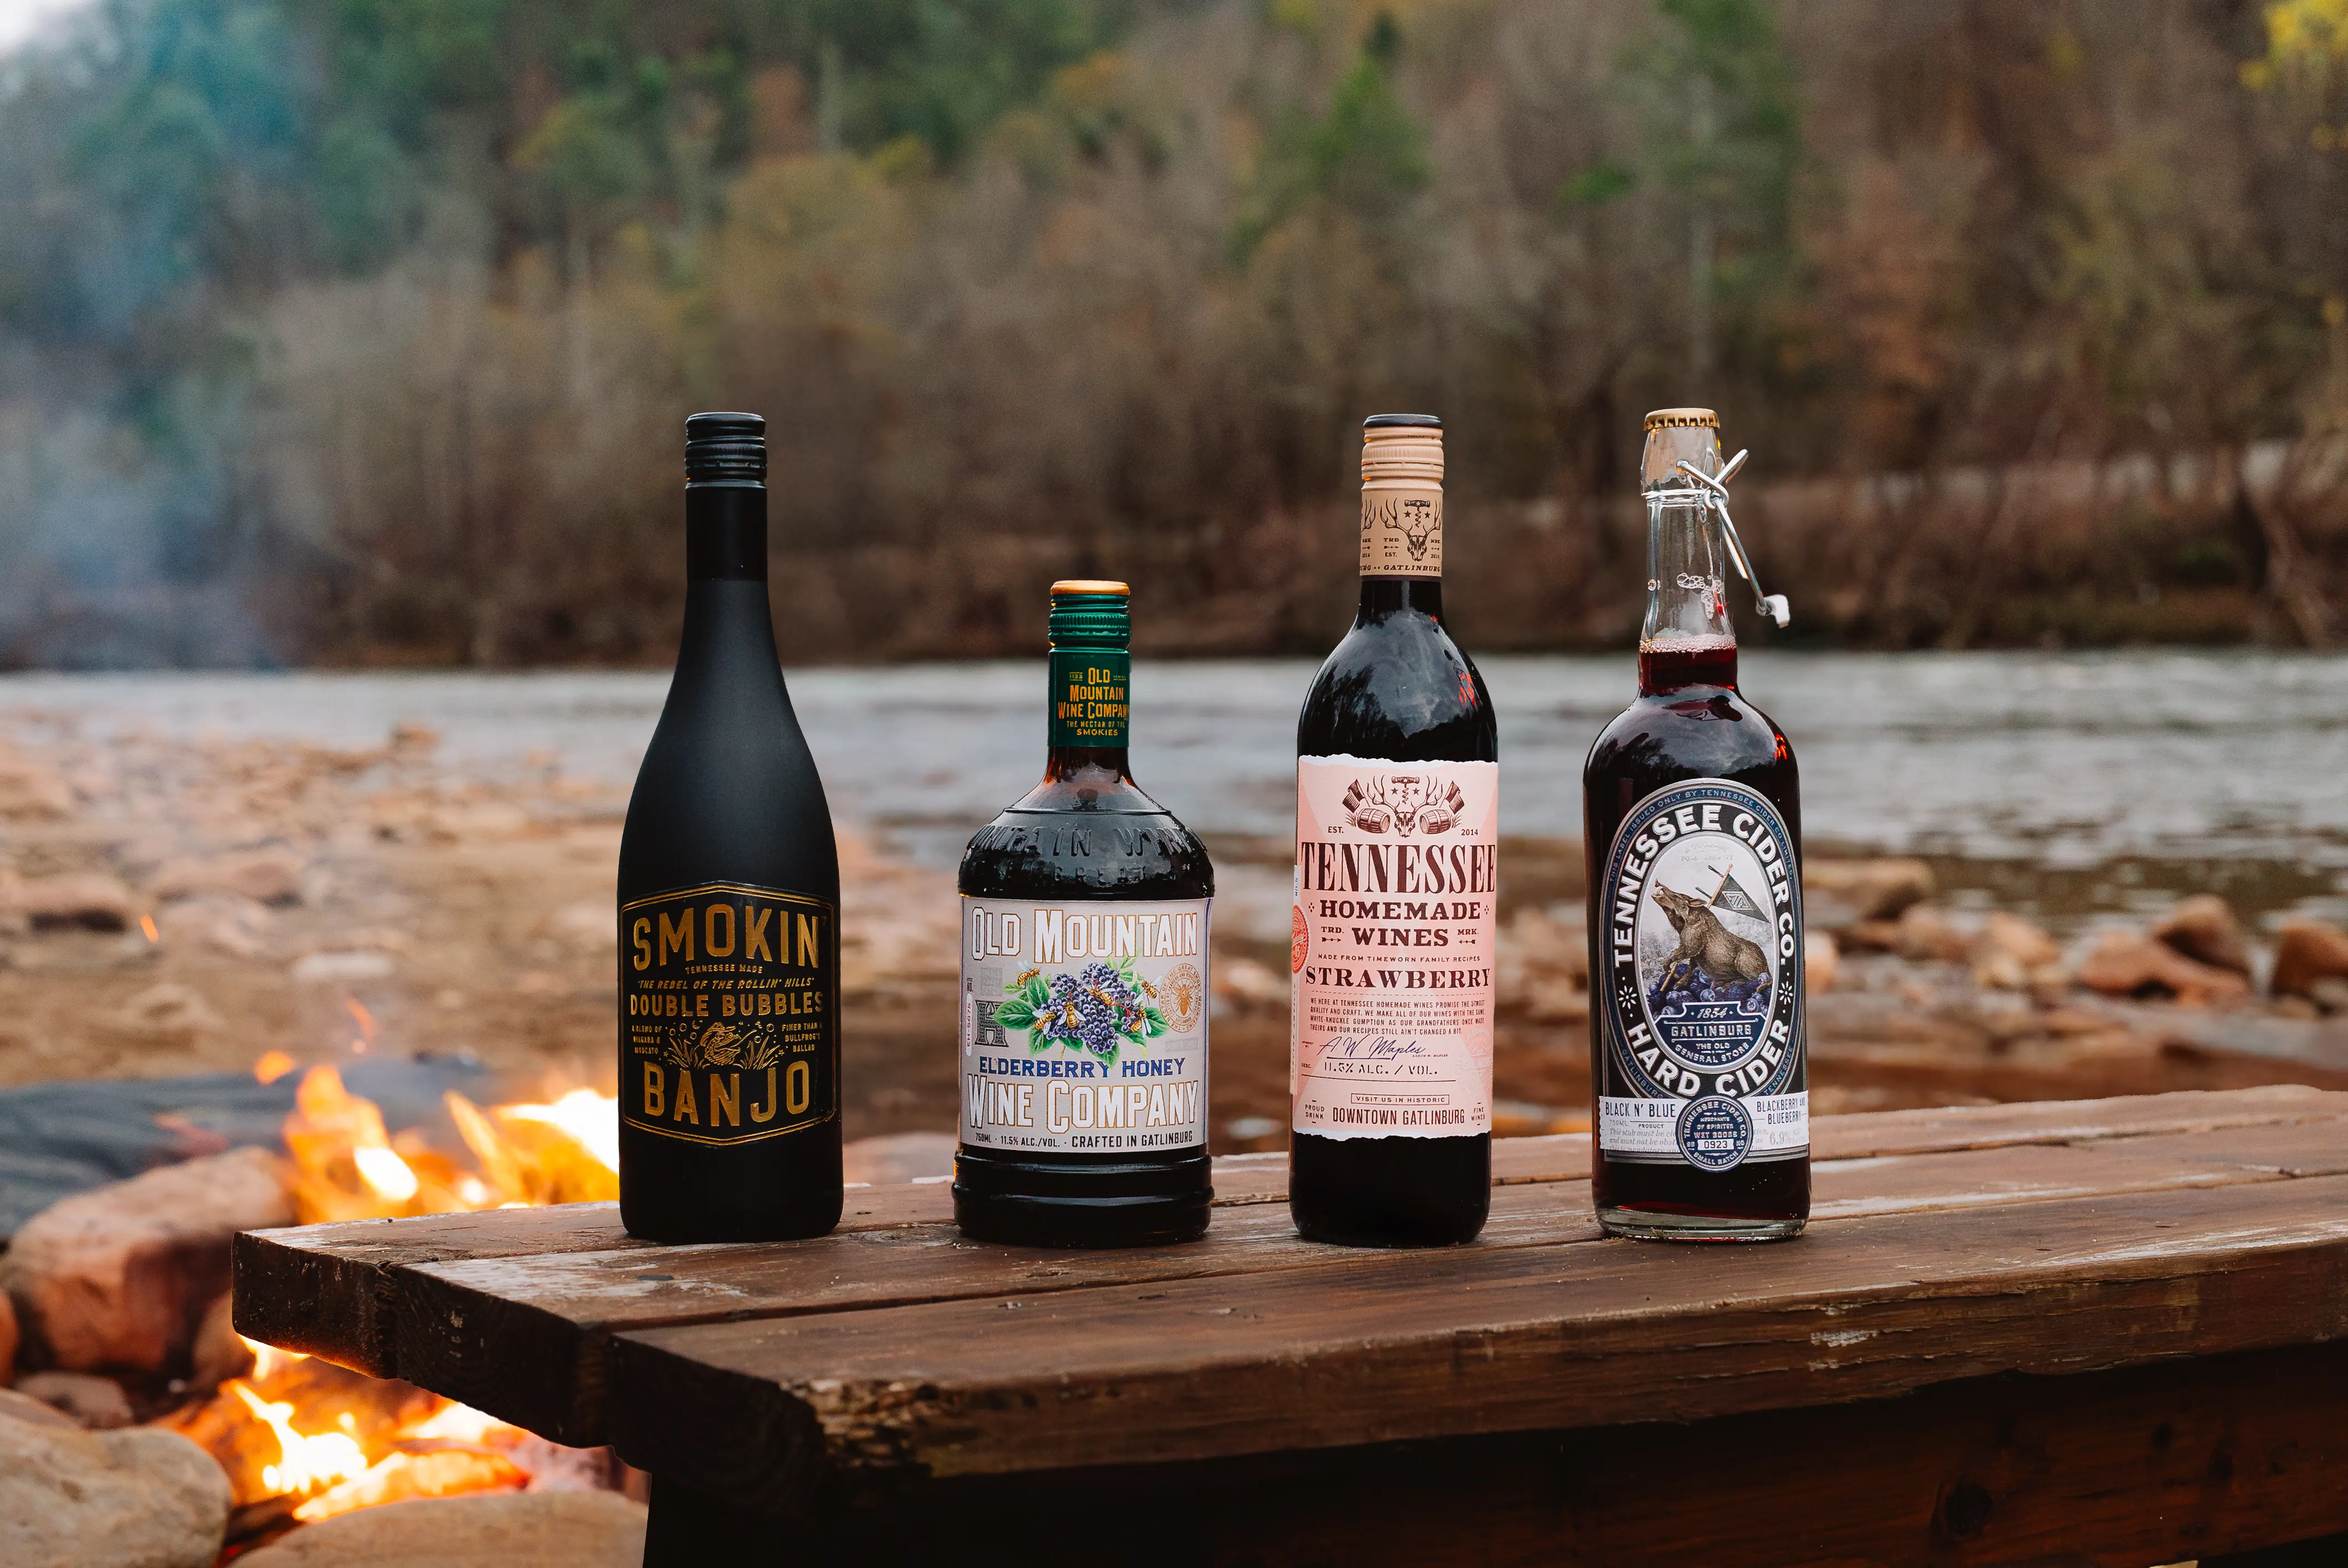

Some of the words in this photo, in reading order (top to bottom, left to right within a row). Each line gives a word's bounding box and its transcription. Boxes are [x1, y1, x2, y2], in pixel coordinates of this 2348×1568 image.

[1088, 668, 1110, 684] OLD
[1070, 685, 1124, 702] MOUNTAIN
[1058, 702, 1083, 719] WINE
[1610, 863, 1618, 881] THIS
[1616, 834, 1630, 859] LABEL
[1630, 806, 1655, 831] ISSUED
[1657, 793, 1680, 807] ONLY
[1701, 790, 1754, 806] TENNESSEE
[1755, 805, 1775, 826] CIDER
[1301, 842, 1495, 894] TENNESSEE
[1614, 804, 1722, 968] TENNESSEE
[1733, 812, 1789, 907] CIDER
[1779, 912, 1794, 965] CO.
[1320, 900, 1480, 920] HOMEMADE
[971, 906, 1021, 961] OLD
[1034, 909, 1197, 964] MOUNTAIN
[1352, 927, 1449, 946] WINES
[686, 964, 735, 974] TENNESSEE
[739, 964, 763, 973] MADE
[1305, 966, 1490, 989] STRAWBERRY
[657, 980, 688, 989] REBEL
[693, 980, 708, 989] OF
[712, 979, 734, 989] THE
[630, 994, 708, 1017] DOUBLE
[722, 992, 823, 1016] BUBBLES
[1697, 1007, 1728, 1019] 1854
[1310, 1015, 1349, 1024] WHITE-KNUCKLE
[1671, 1025, 1751, 1036] GATLINBURG
[793, 1044, 815, 1052] BALLAD
[1369, 1036, 1426, 1060] Maples
[1675, 1044, 1718, 1063] GENERAL
[1721, 1042, 1749, 1062] STORE
[979, 1056, 1109, 1078] ELDERBERRY
[1121, 1058, 1186, 1078] HONEY
[1627, 1022, 1701, 1096] HARD
[1716, 1019, 1789, 1097] CIDER
[1325, 1062, 1353, 1073] 11.5%
[1359, 1064, 1388, 1074] ALC.
[1394, 1065, 1403, 1075] /
[1409, 1065, 1438, 1075] VOL.
[1764, 1045, 1793, 1095] TENNESSEE
[644, 1061, 809, 1126] BANJO
[967, 1074, 1034, 1129] WINE
[1046, 1080, 1198, 1134] COMPANY
[1605, 1102, 1629, 1117] BLACK
[1649, 1103, 1676, 1117] BLUE
[1757, 1098, 1798, 1112] BLACKBERRY
[1332, 1107, 1397, 1125] DOWNTOWN
[1403, 1108, 1465, 1125] GATLINBURG
[1684, 1101, 1719, 1138] TENNESSEE
[1721, 1102, 1743, 1123] CIDER
[1768, 1111, 1801, 1125] BLUEBERRY
[975, 1133, 991, 1143] 750ML
[1001, 1136, 1018, 1145] 11.5%
[1021, 1137, 1060, 1147] ALC./VOL.
[1072, 1136, 1122, 1147] CRAFTED
[1127, 1135, 1137, 1147] IN
[1142, 1130, 1192, 1146] GATLINBURG
[1693, 1152, 1716, 1165] SMALL
[1717, 1151, 1739, 1164] BATCH
